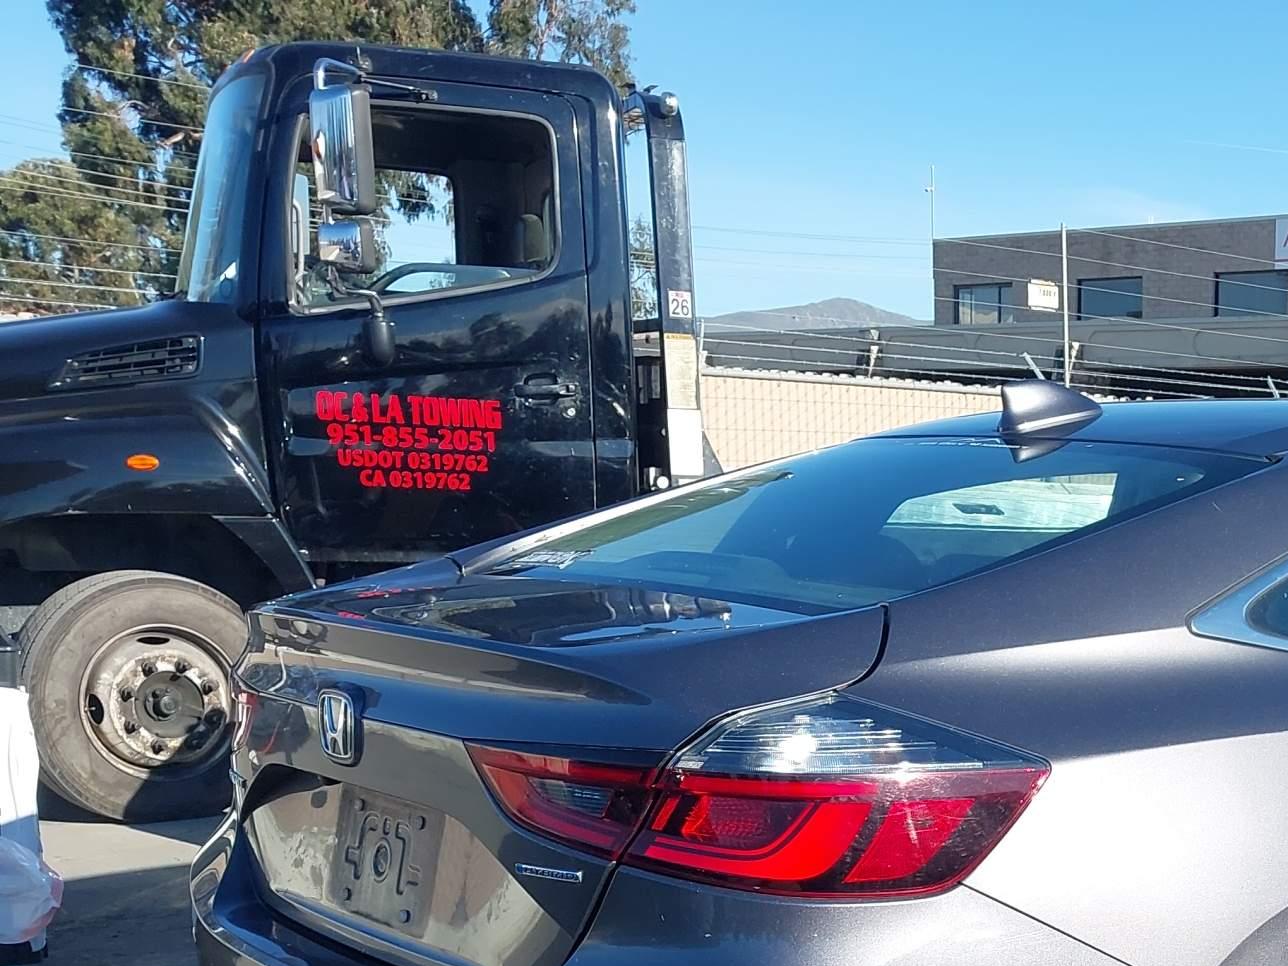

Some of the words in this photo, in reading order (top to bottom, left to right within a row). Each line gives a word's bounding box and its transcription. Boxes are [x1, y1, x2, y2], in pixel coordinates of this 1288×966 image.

[670, 298, 690, 316] 26
[315, 389, 350, 422] OC
[351, 391, 370, 424] &
[371, 393, 406, 426] LA
[407, 395, 503, 430] TOWING
[326, 423, 496, 452] 951-855-2051
[337, 447, 404, 469] USDOT
[408, 451, 489, 473] 0319762
[359, 469, 387, 488] CA
[388, 471, 471, 491] 0319762
